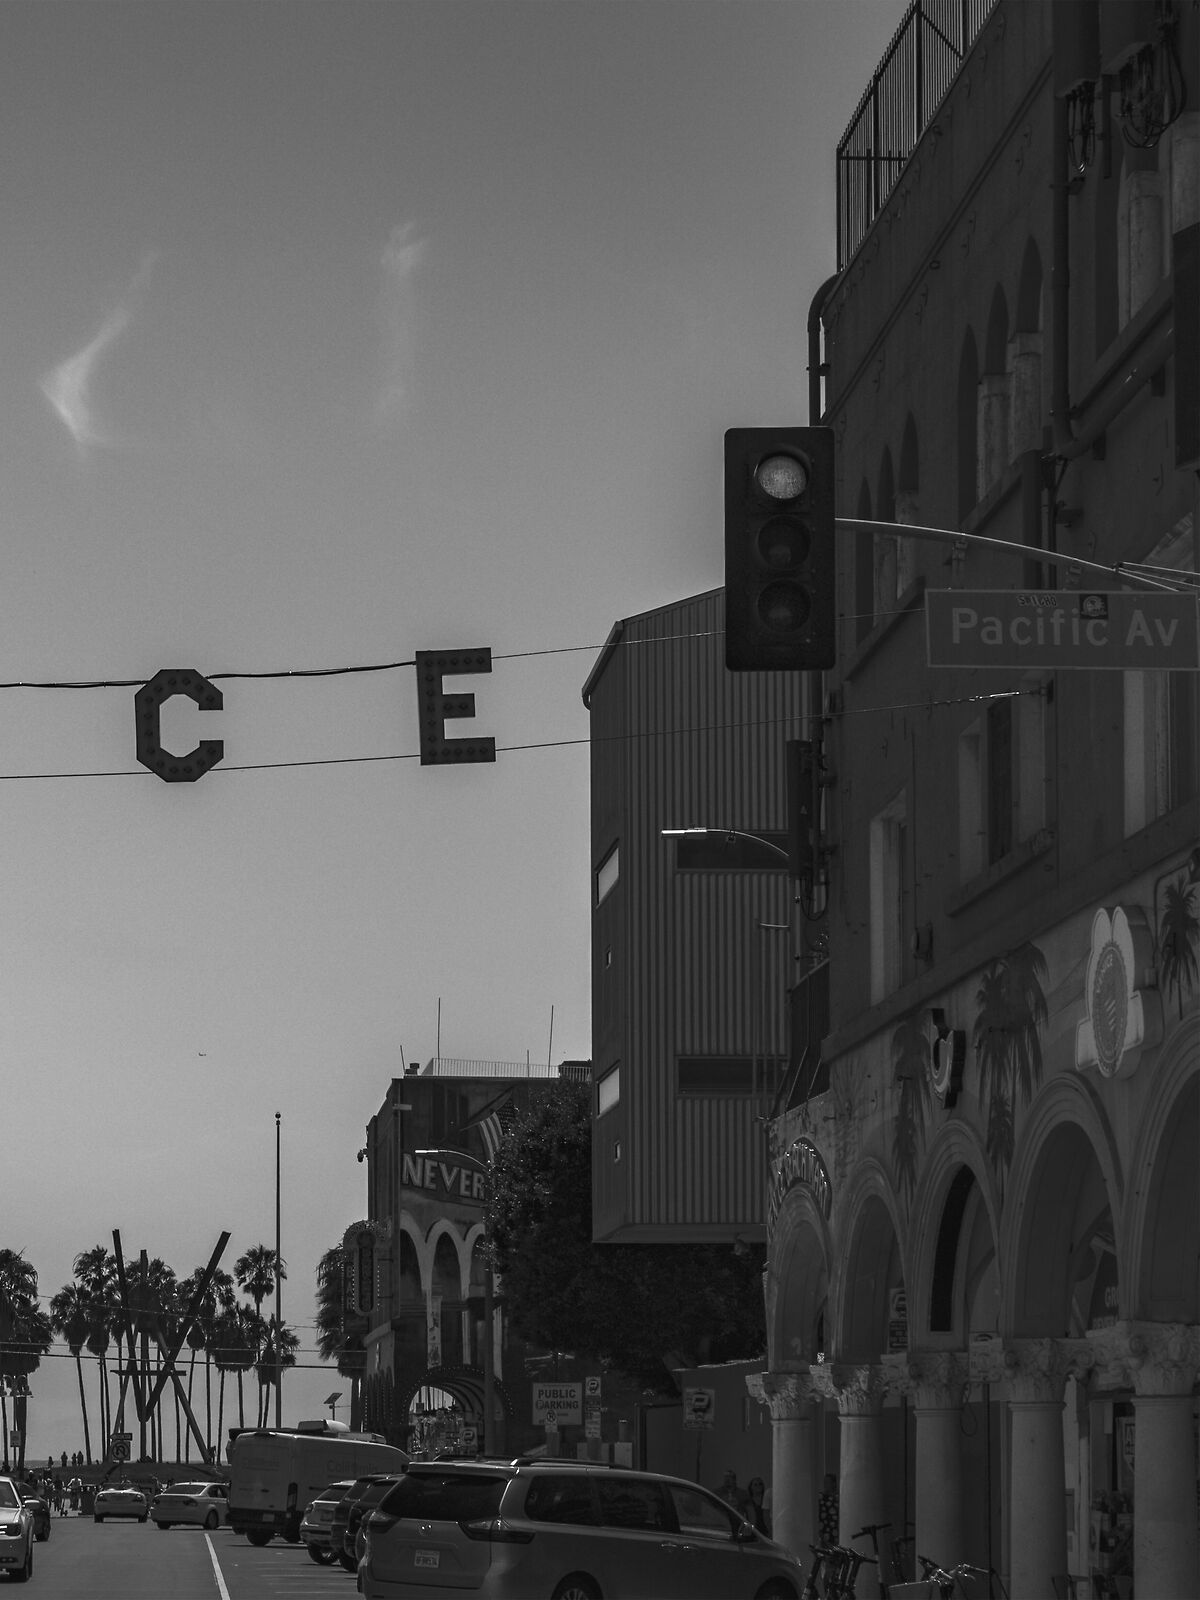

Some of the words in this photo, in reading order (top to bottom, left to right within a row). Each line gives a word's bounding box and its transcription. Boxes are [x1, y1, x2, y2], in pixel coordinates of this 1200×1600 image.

[951, 606, 1108, 647] Pacific
[1125, 609, 1179, 647] Av
[402, 1153, 486, 1201] NEVER
[346, 1264, 354, 1310] BAR
[536, 1400, 579, 1410] PARKING
[538, 1389, 576, 1399] PUBLIC
